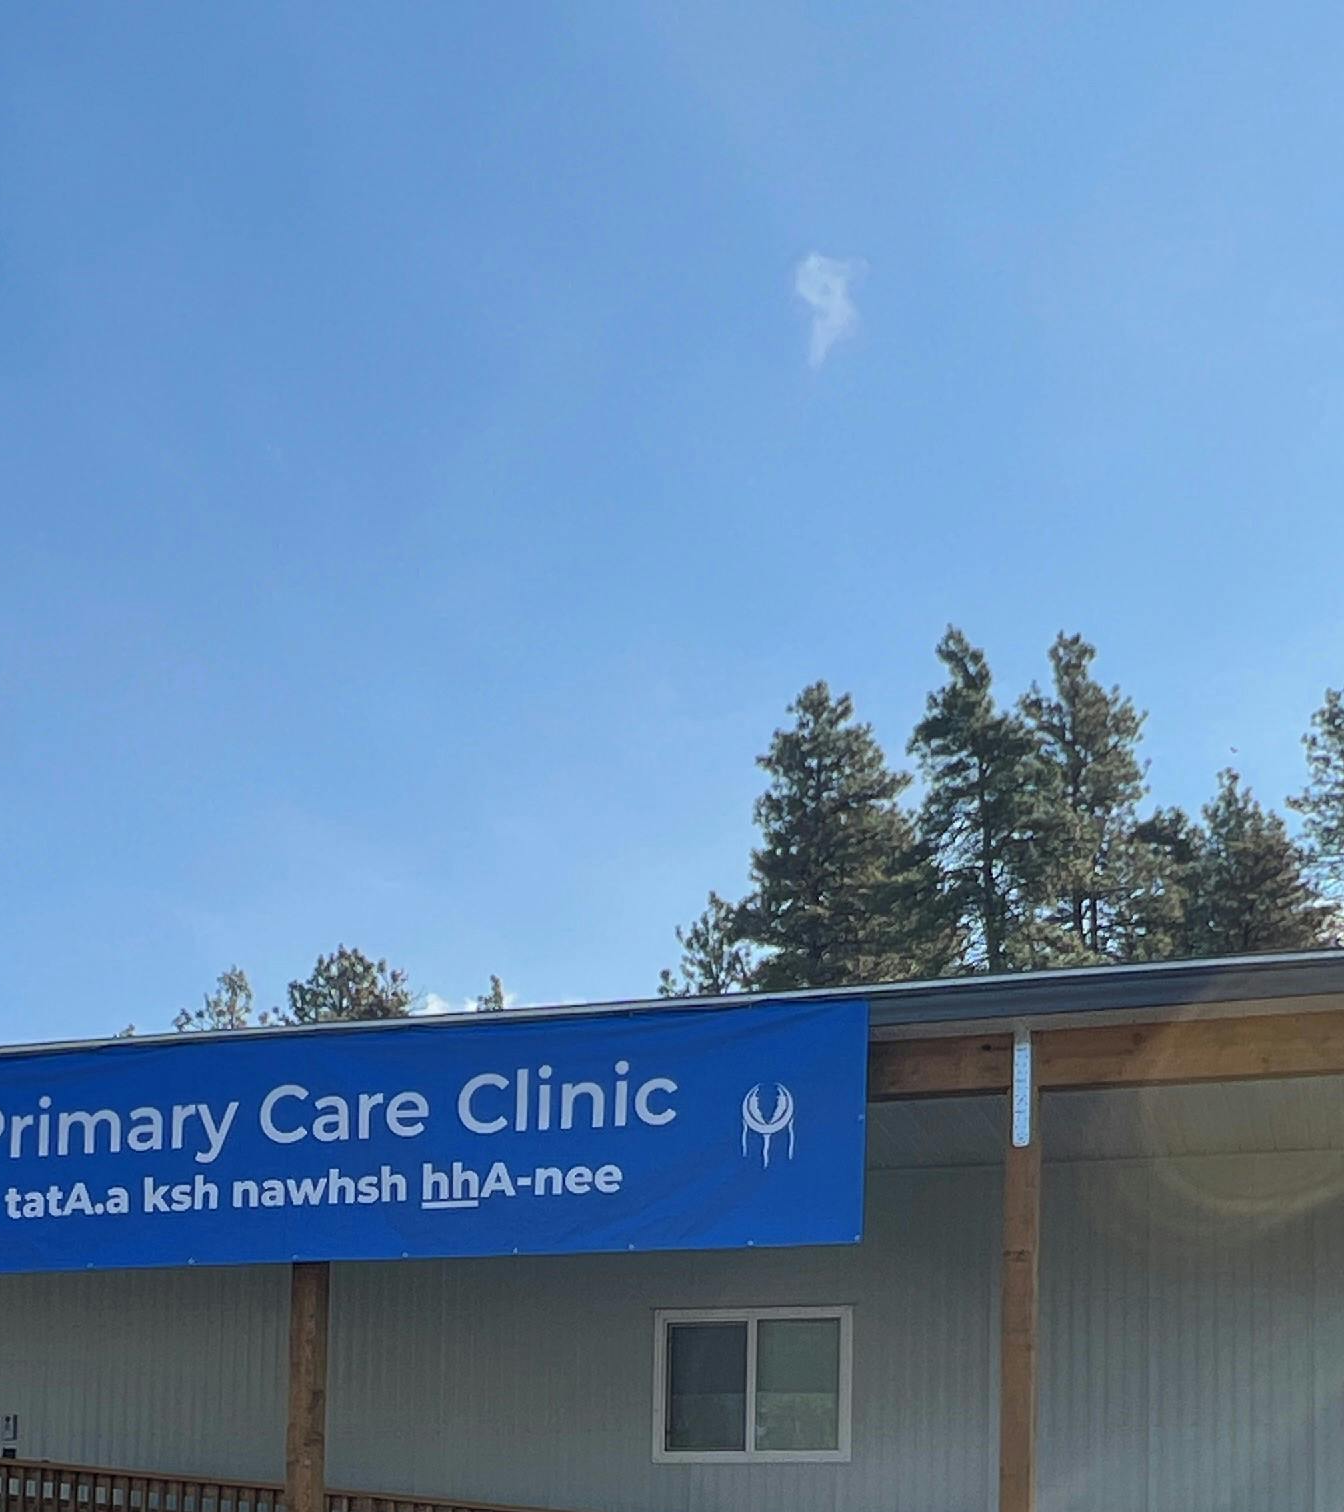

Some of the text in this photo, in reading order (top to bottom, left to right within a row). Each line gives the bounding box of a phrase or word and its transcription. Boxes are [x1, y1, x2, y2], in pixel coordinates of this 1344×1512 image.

[260, 1083, 429, 1144] Care
[458, 1059, 678, 1134] Clinic
[5, 1161, 623, 1219] tatA.a ksh nawhsh hhA-nee
